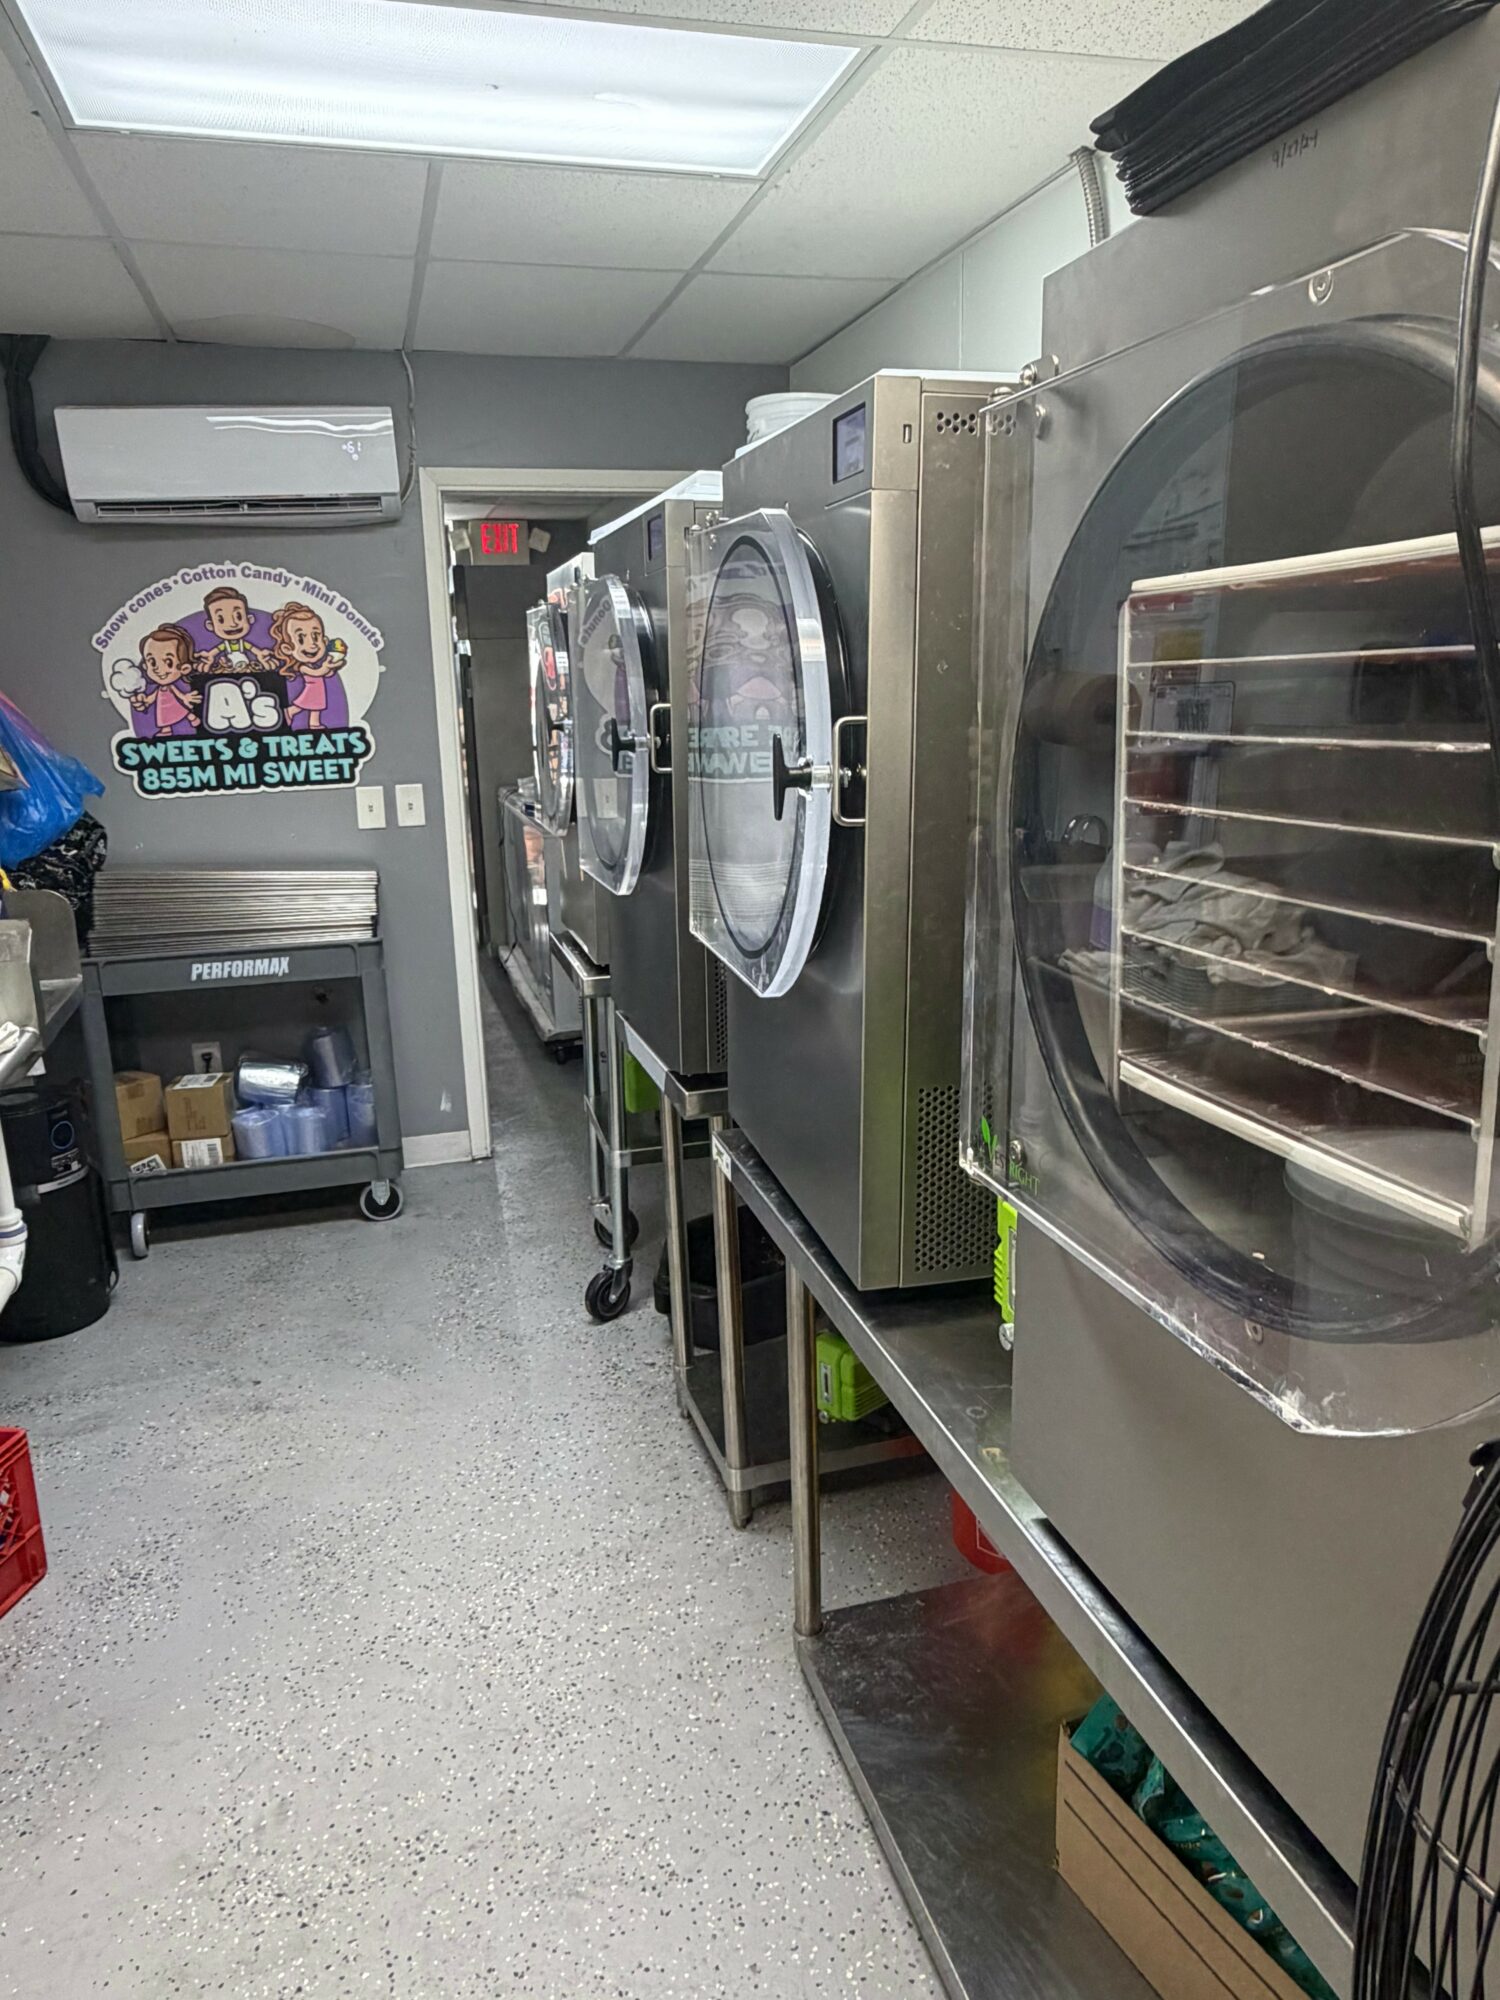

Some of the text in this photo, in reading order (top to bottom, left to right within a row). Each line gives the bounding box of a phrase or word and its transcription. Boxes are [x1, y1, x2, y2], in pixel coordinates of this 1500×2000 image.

[481, 523, 519, 554] EXIT
[95, 565, 381, 649] Snow cones Cotton Candy Mini Donuts
[206, 681, 280, 730] A's
[121, 732, 367, 765] SWEETS & TREATS
[143, 758, 354, 790] 855M MI SWEET
[191, 956, 290, 981] PERFORMAX
